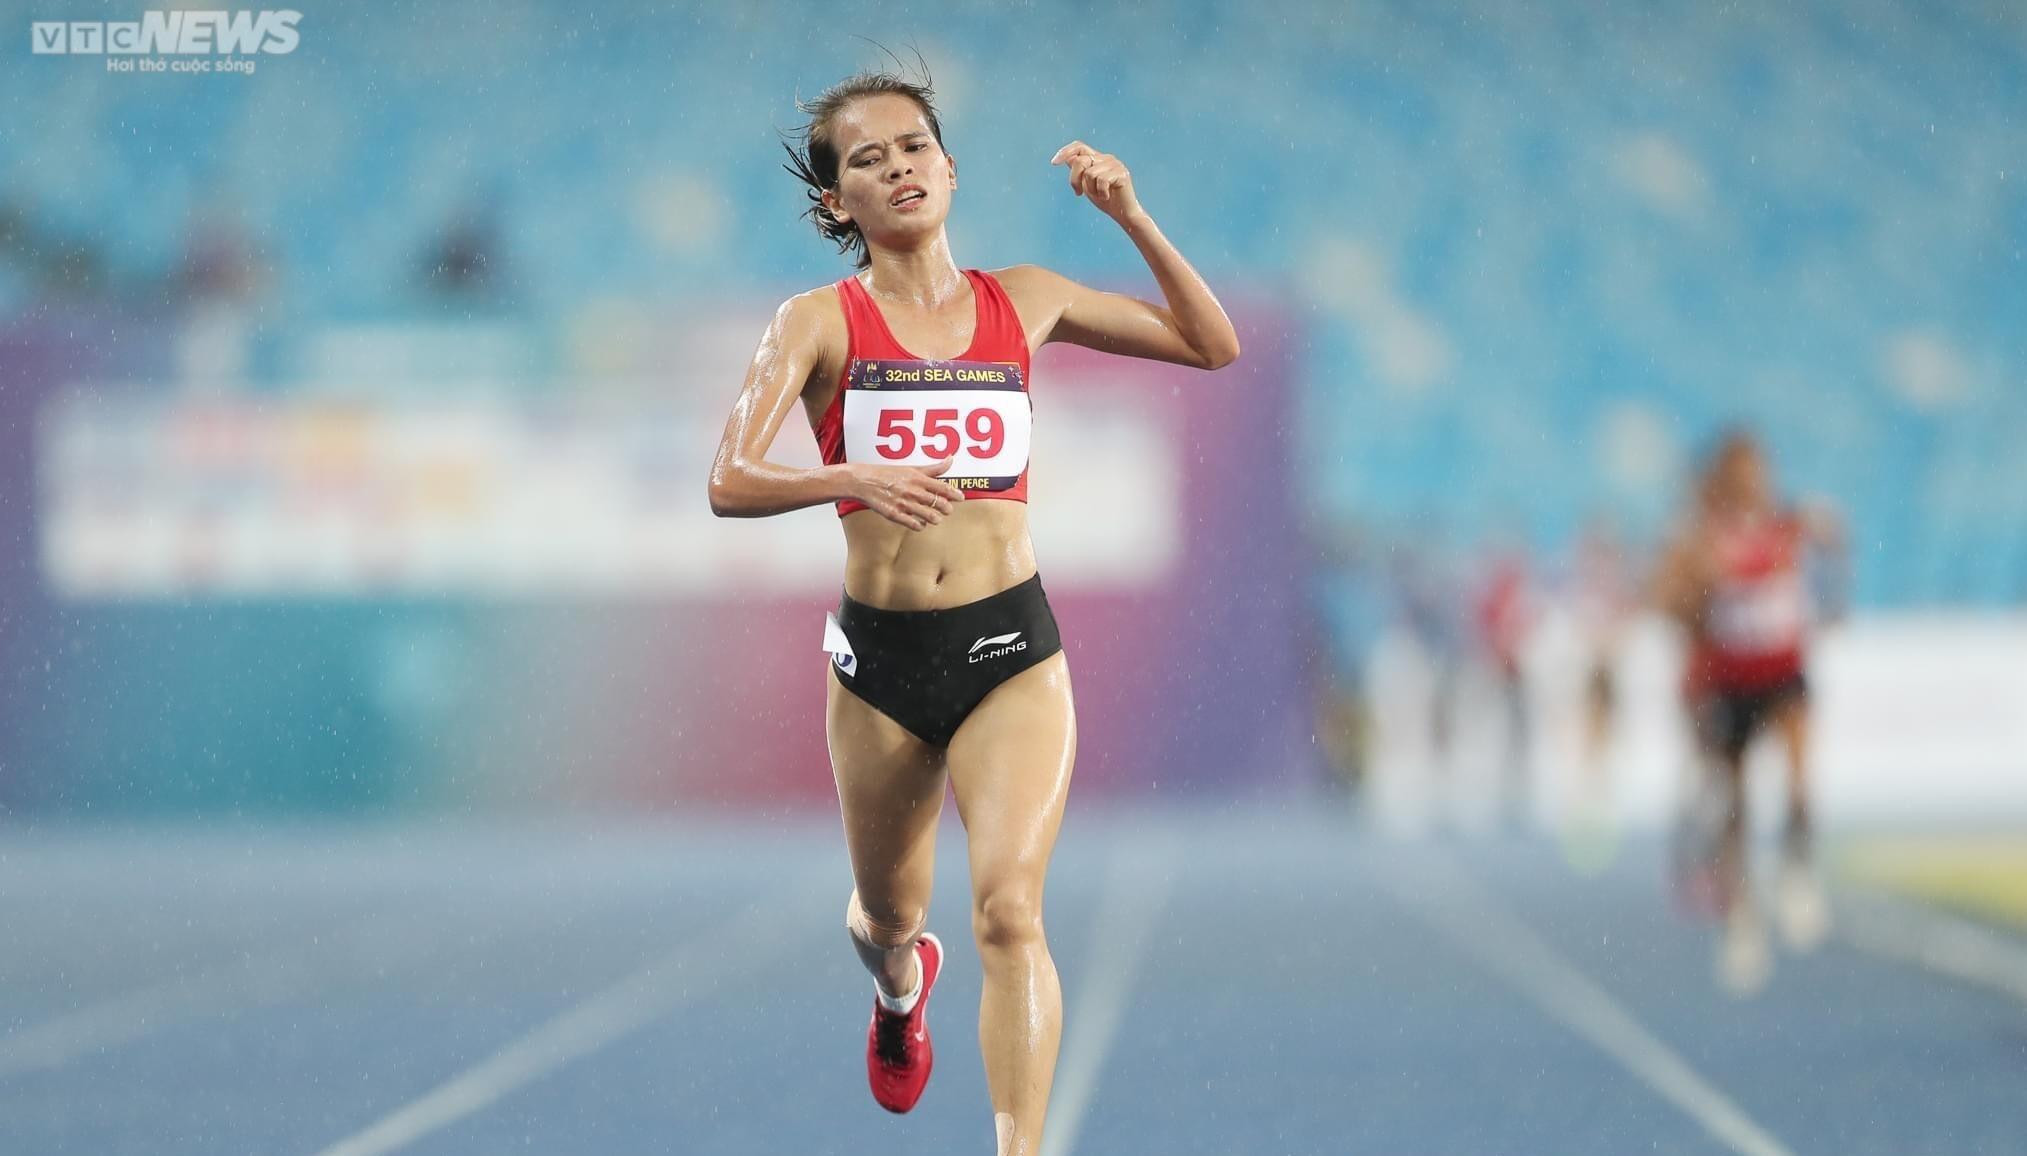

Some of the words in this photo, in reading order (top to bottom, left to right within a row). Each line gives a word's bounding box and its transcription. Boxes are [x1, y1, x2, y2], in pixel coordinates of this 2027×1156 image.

[885, 369, 920, 382] 32nd
[924, 369, 953, 382] SEA
[956, 370, 1006, 383] GAMES
[875, 408, 1005, 460] 559
[949, 478, 959, 489] IN
[961, 478, 990, 489] PEACE
[968, 641, 1027, 664] LI-NING
